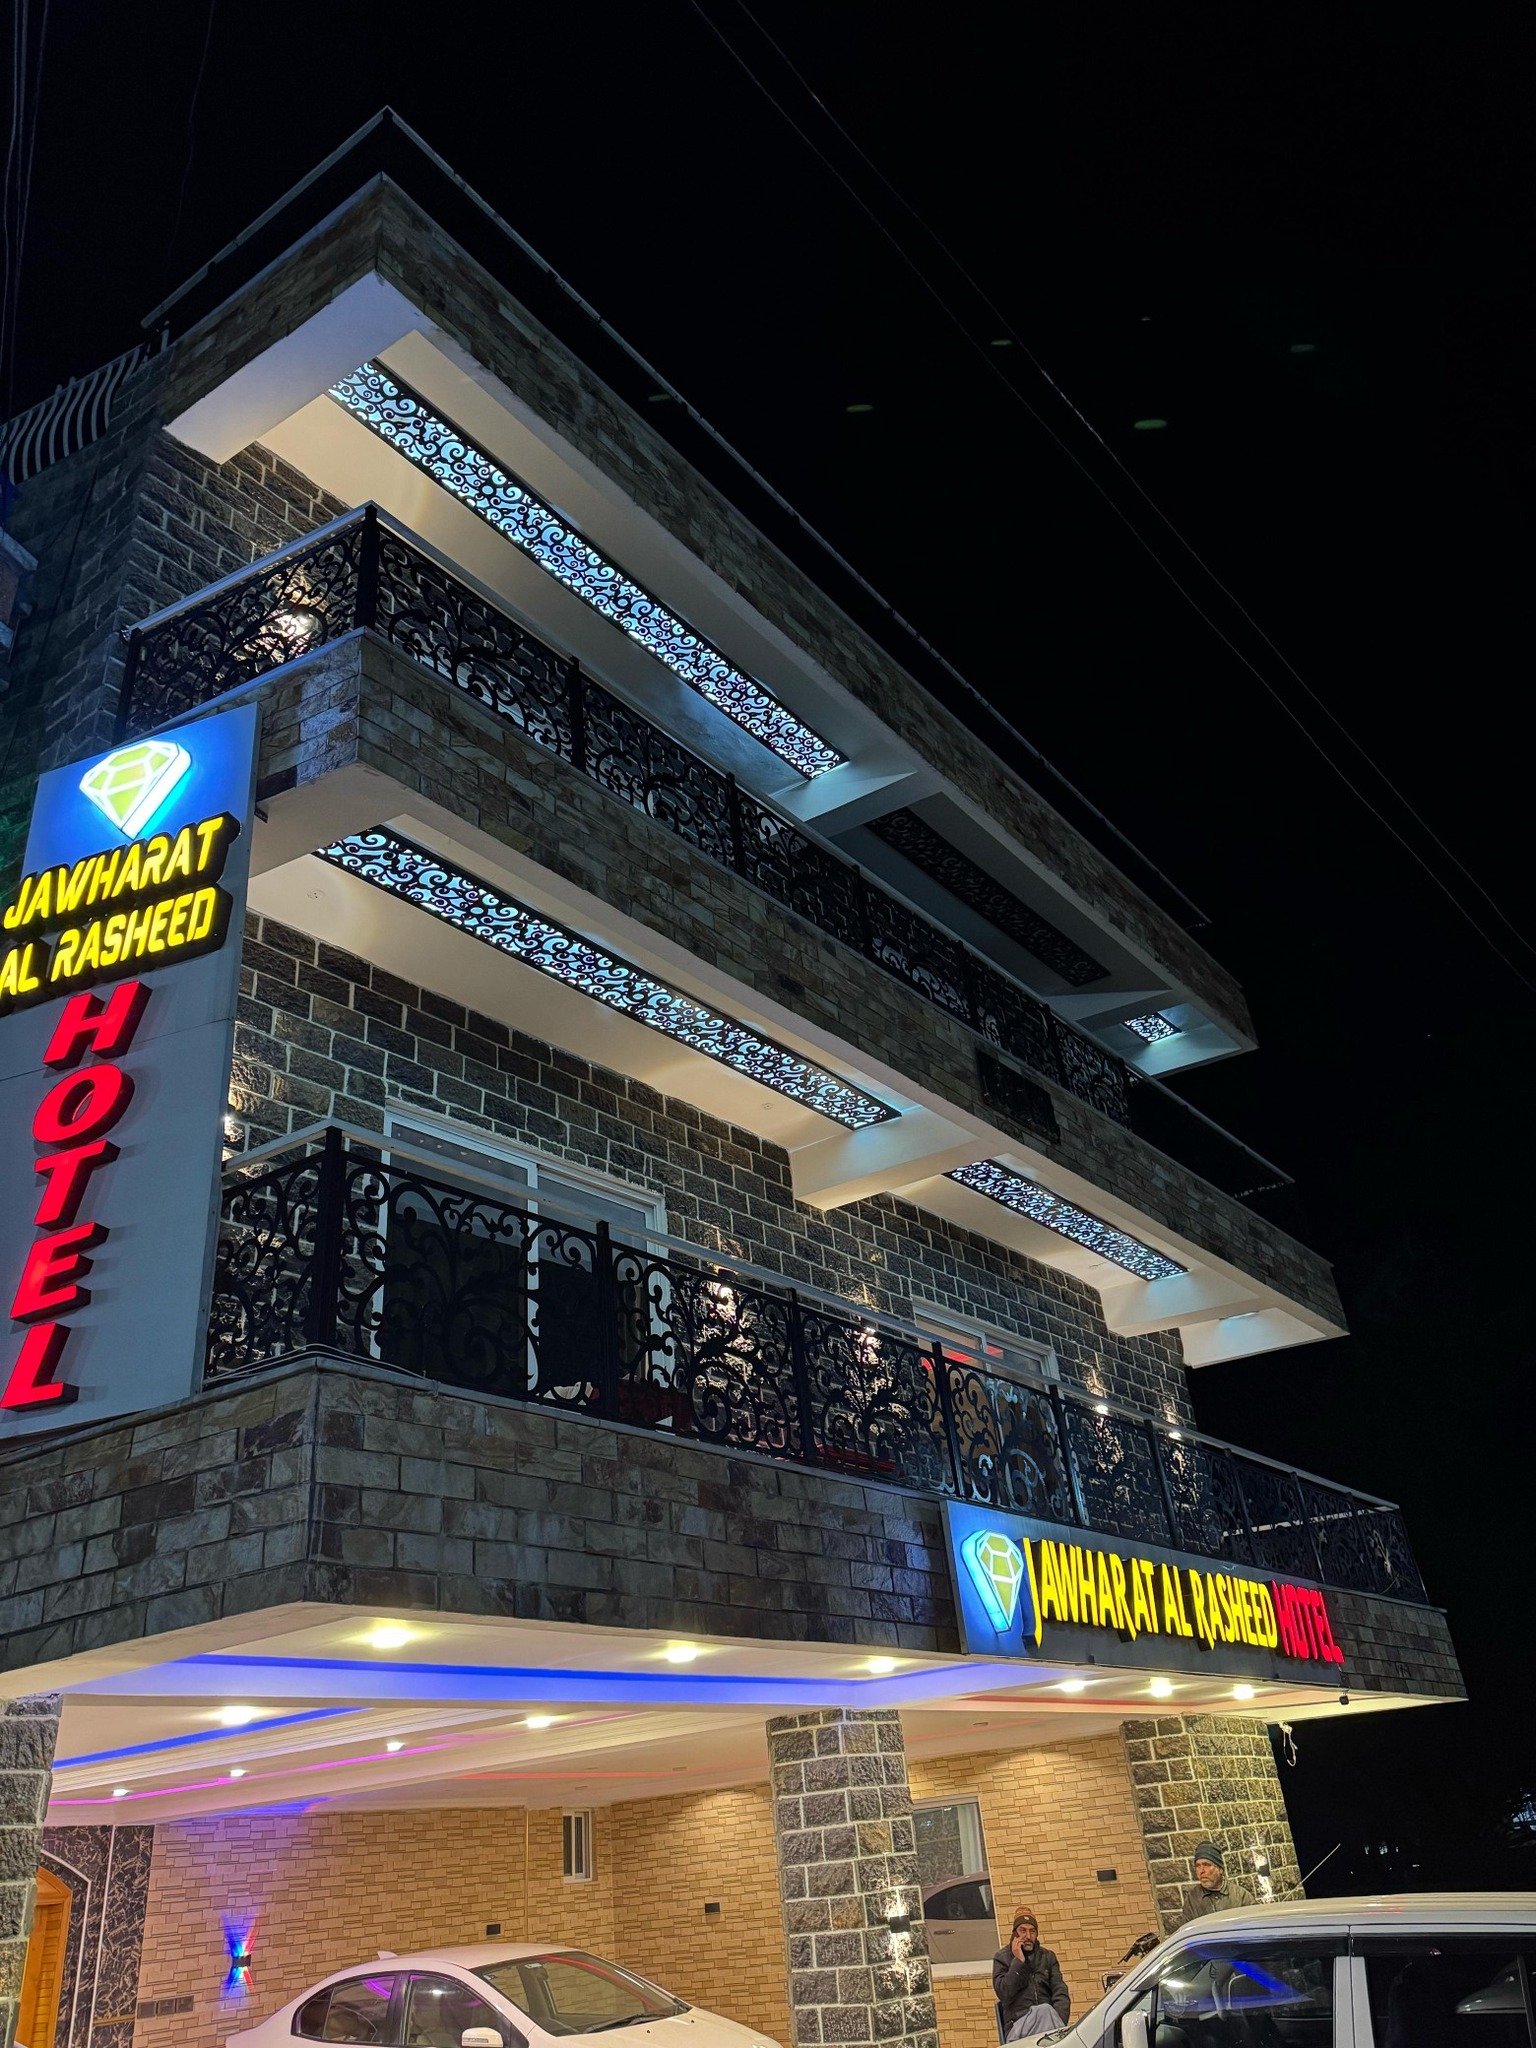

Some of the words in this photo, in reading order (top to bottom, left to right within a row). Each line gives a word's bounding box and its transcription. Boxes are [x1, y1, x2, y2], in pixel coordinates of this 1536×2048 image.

[3, 815, 224, 931] JAWHARAT
[0, 943, 40, 997] AL
[50, 886, 217, 984] RASHEED
[0, 980, 143, 1410] HOTEL
[1022, 1537, 1159, 1648] JAWHARAT
[1161, 1562, 1194, 1638] AL
[1187, 1568, 1278, 1651] RASHEED
[1271, 1579, 1345, 1664] HOTEL
